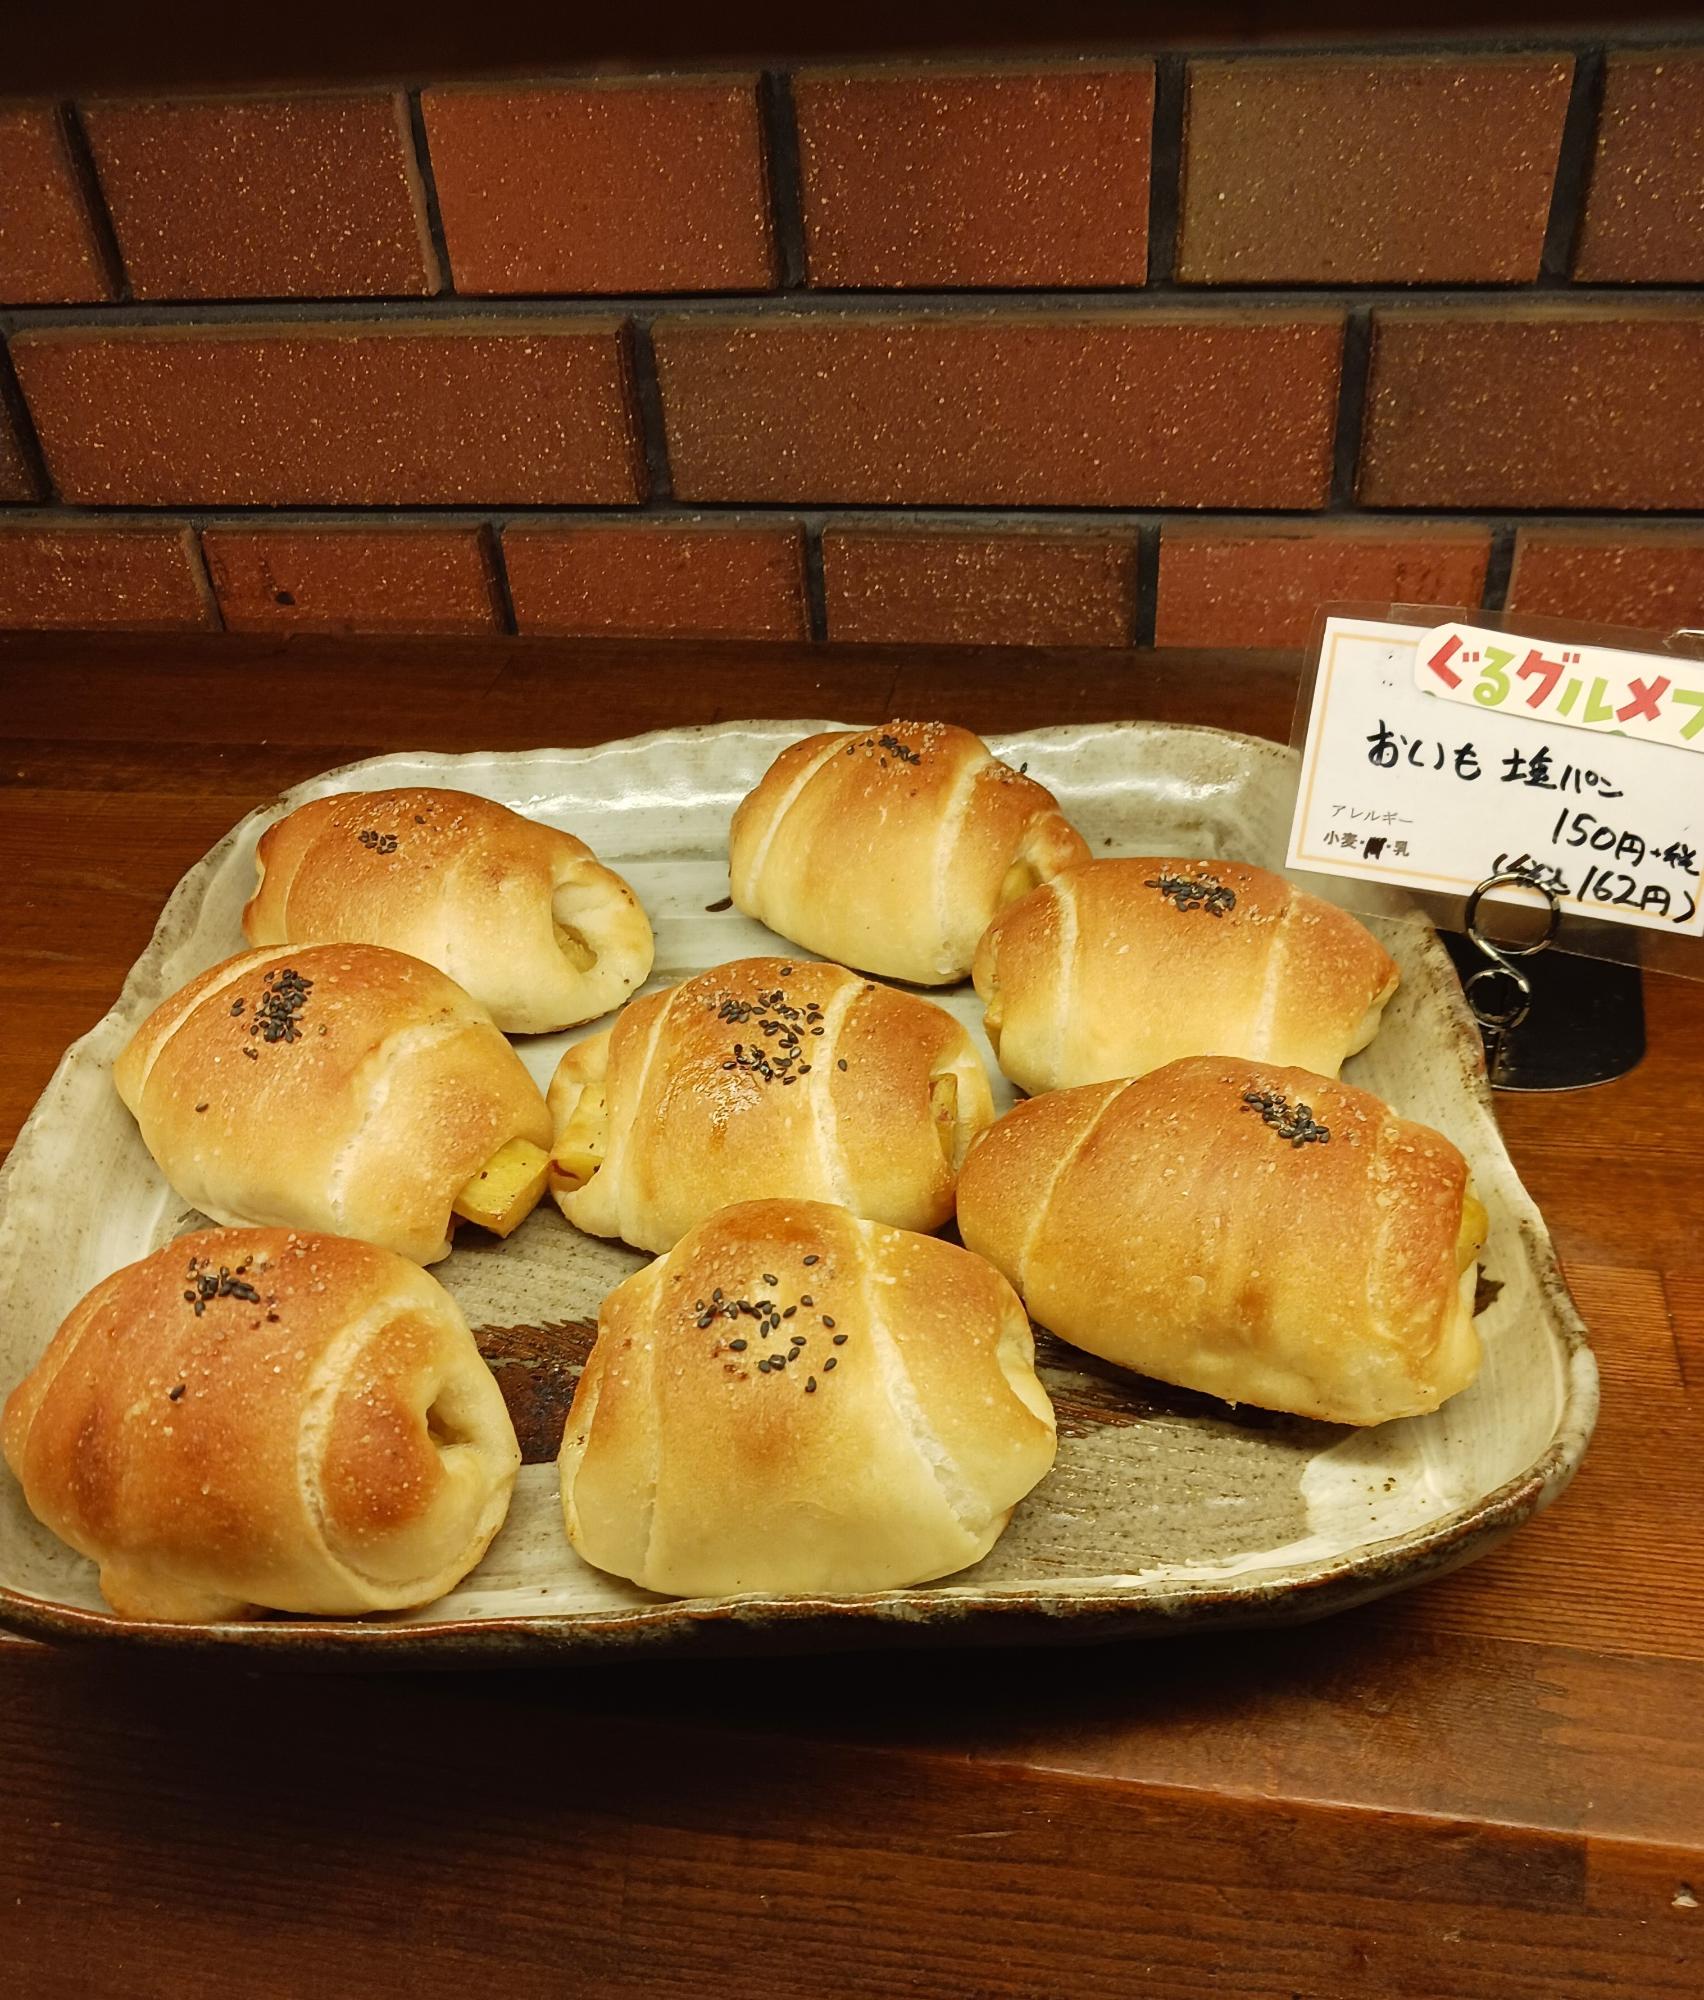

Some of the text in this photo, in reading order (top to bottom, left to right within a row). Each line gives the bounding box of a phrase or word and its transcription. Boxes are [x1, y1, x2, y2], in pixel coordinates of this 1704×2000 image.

[1366, 719, 1624, 798] おいも 塩パン
[1331, 804, 1414, 826] アレルギー
[1323, 830, 1410, 860] 小麦・・乳
